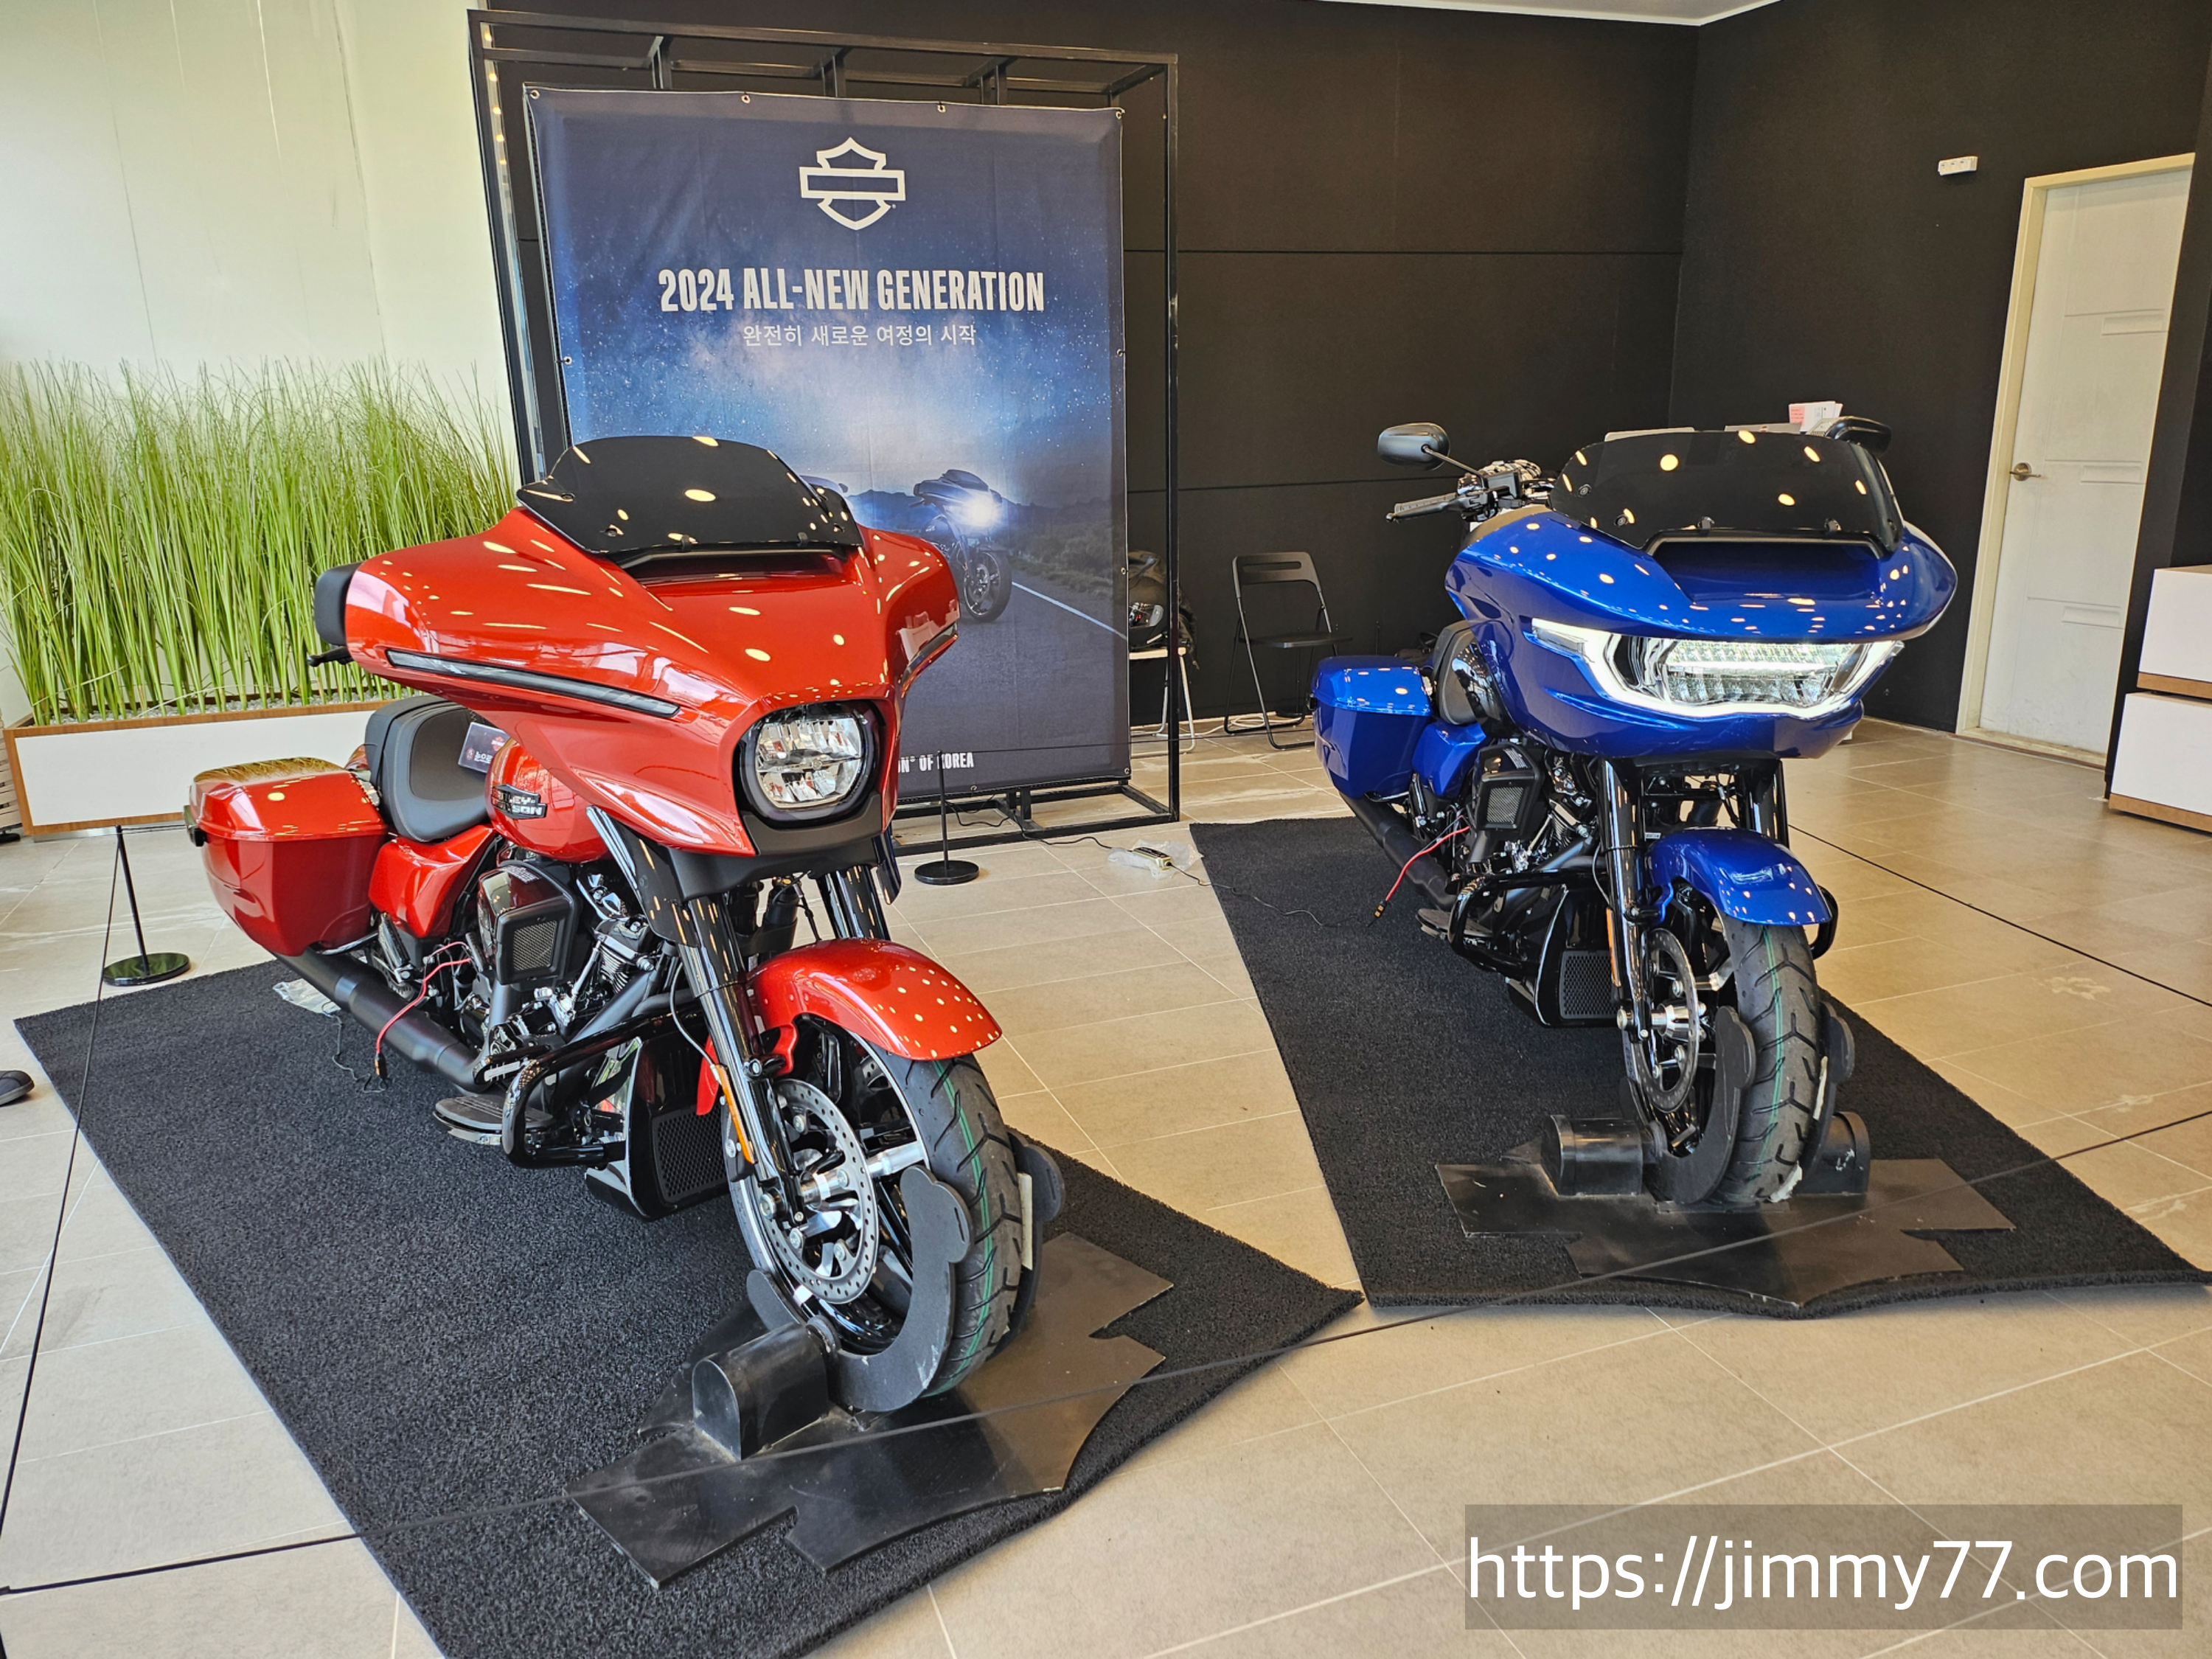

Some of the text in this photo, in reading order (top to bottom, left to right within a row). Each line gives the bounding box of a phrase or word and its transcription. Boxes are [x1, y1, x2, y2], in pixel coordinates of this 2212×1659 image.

[658, 268, 1044, 311] 2024 ALL-NEW GENERATION
[743, 324, 976, 347] 완전히 새로운 여정의 시작
[919, 754, 933, 771] OF
